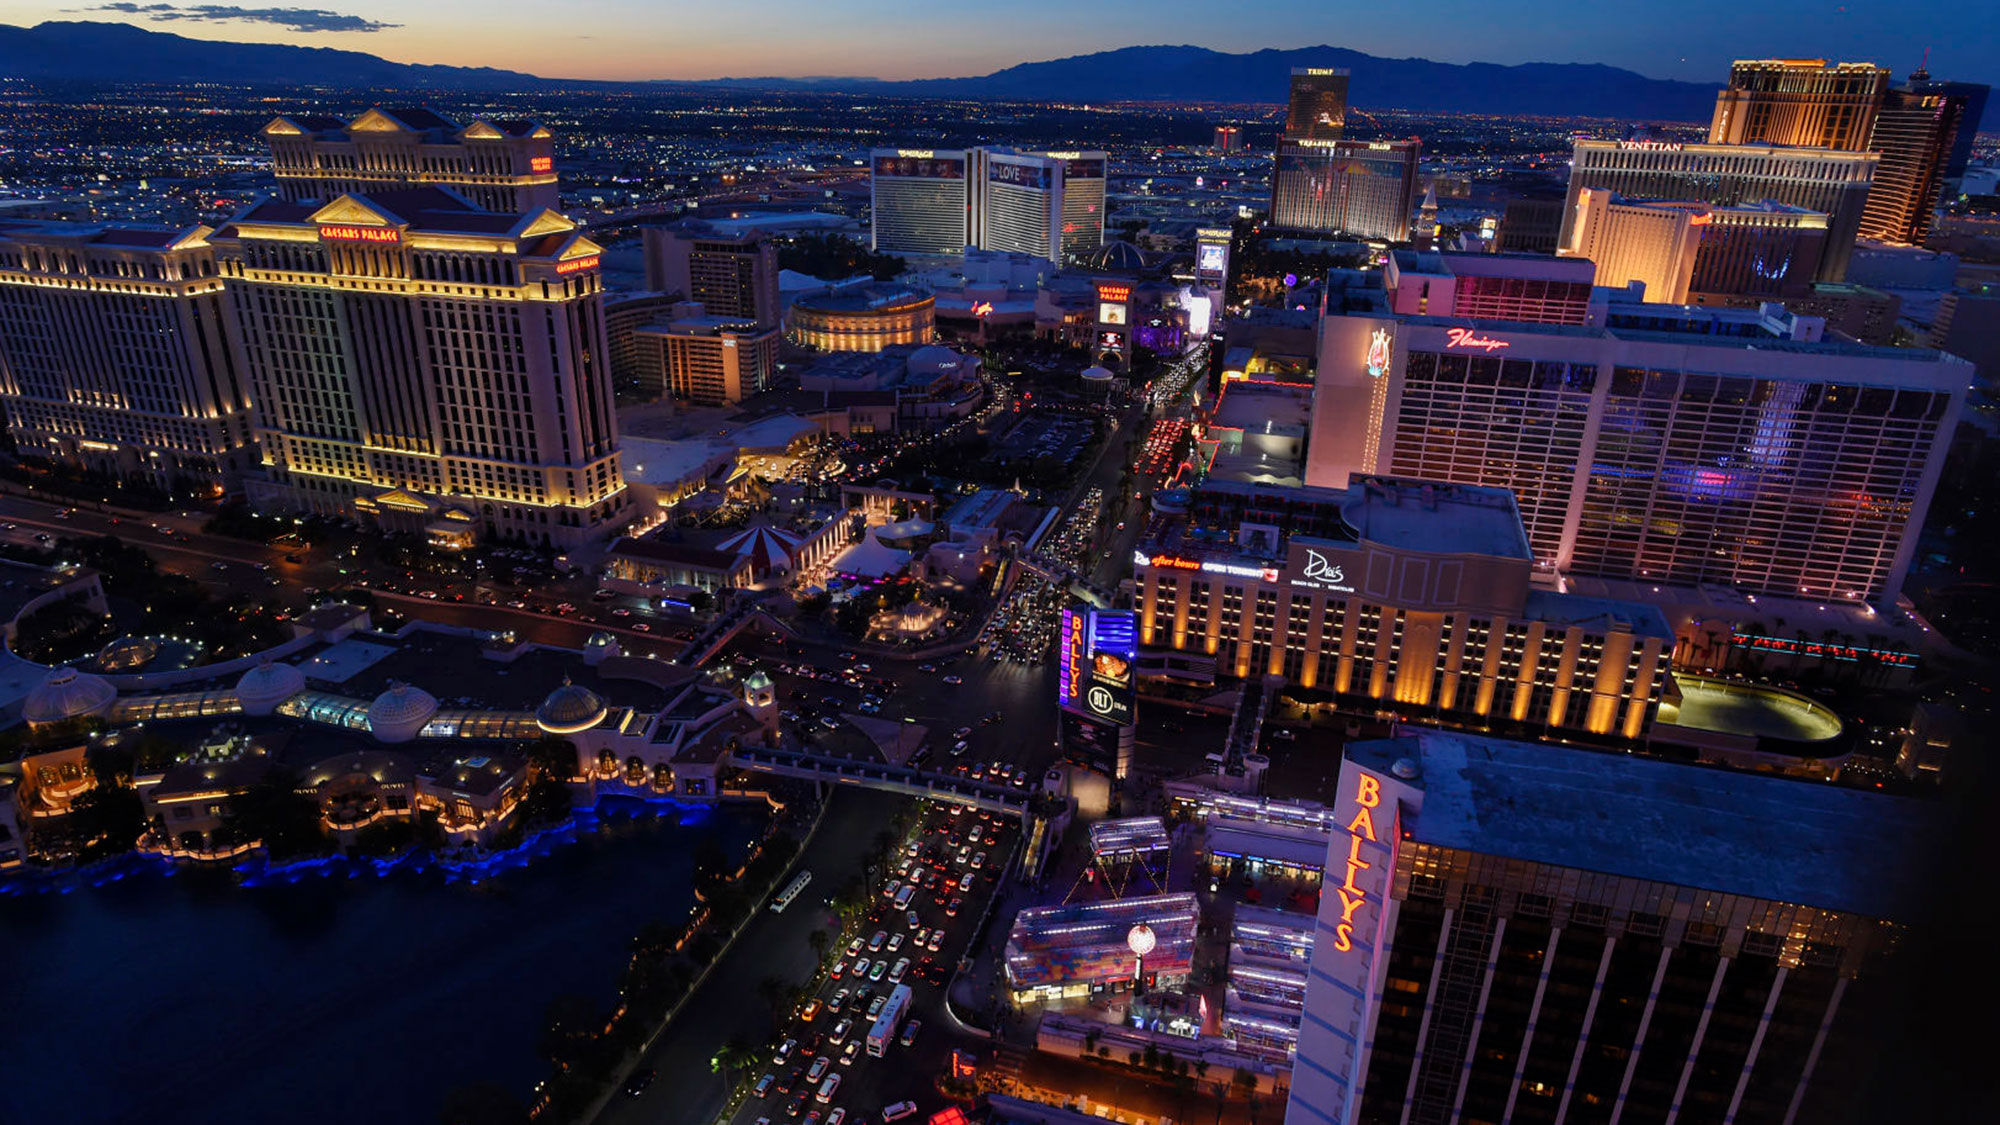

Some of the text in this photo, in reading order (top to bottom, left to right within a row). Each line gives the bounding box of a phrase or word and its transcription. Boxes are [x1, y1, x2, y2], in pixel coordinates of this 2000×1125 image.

[1620, 141, 1682, 152] VENETIAN
[999, 165, 1020, 181] LOVE
[320, 227, 398, 242] CAESARS PALACE
[1098, 285, 1130, 295] CAESARS
[1099, 293, 1128, 301] PALACE
[1446, 327, 1510, 353] Flamingo
[1151, 555, 1174, 567] after
[1174, 557, 1200, 570] hours
[1303, 549, 1344, 583] Drai's
[1093, 690, 1109, 709] BLT
